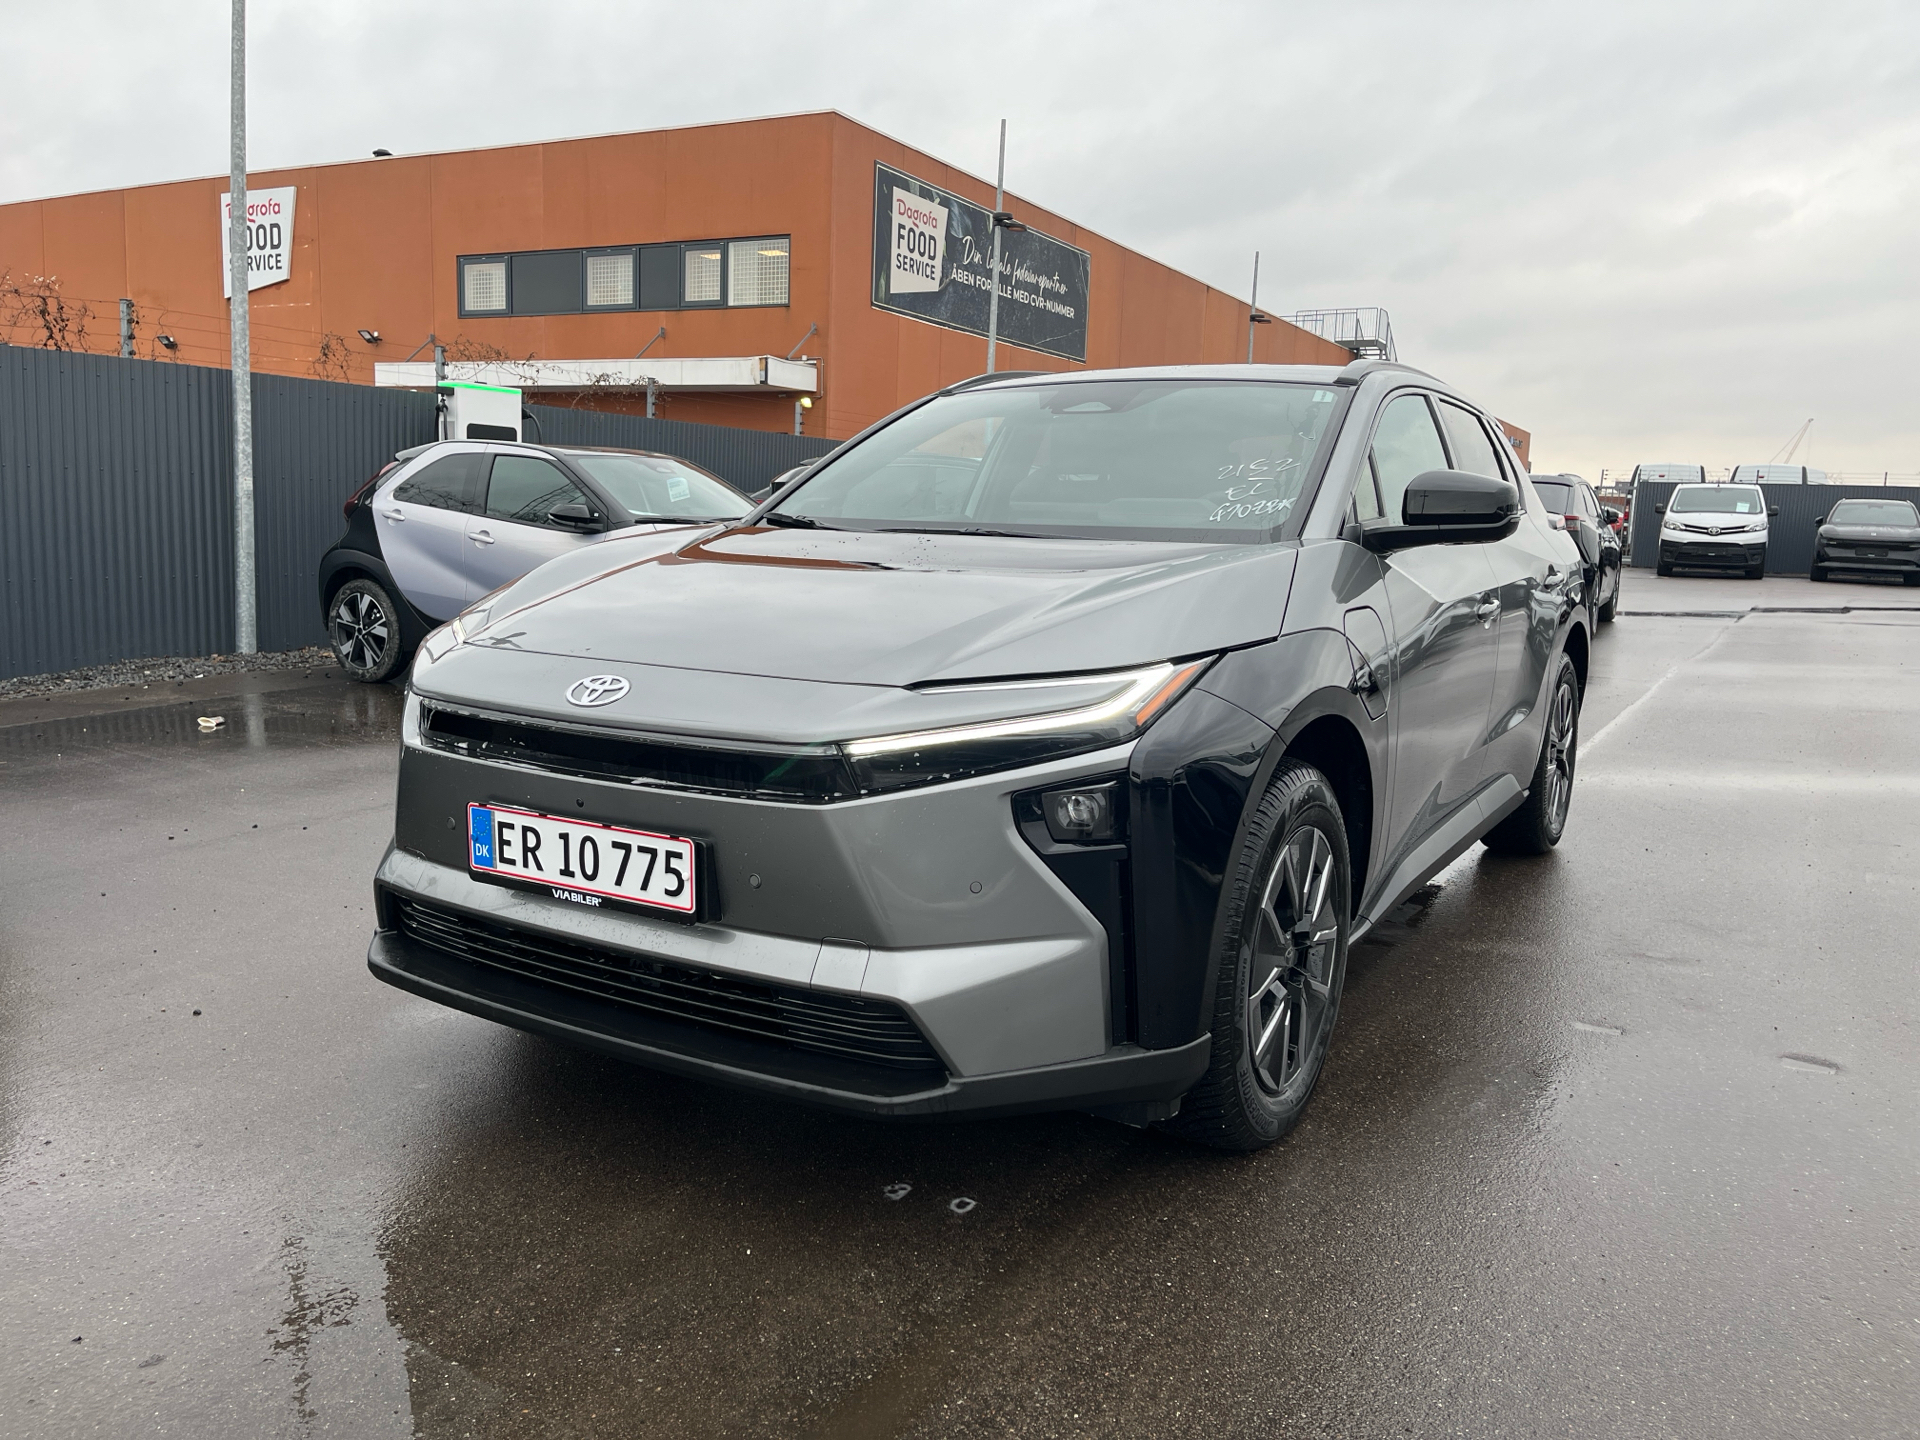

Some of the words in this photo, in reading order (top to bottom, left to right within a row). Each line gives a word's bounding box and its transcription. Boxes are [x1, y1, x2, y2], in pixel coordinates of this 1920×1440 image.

[225, 198, 281, 224] grofa
[896, 198, 938, 229] Dagrofa
[229, 223, 282, 253] OOD
[897, 222, 937, 261] FOOD
[229, 253, 283, 272] RVICE
[896, 252, 936, 281] SERVICE
[962, 236, 982, 265] Din
[986, 245, 1012, 276] loale
[951, 263, 975, 287] ÅBEN
[998, 283, 1012, 299] LLE
[1012, 288, 1030, 304] MED
[1030, 294, 1075, 319] CVR-NUMMER
[475, 843, 490, 858] DK
[497, 820, 544, 872] ER
[558, 832, 600, 882] 10
[611, 840, 685, 897] 775
[1238, 1066, 1275, 1135] BRIDGESTONE
